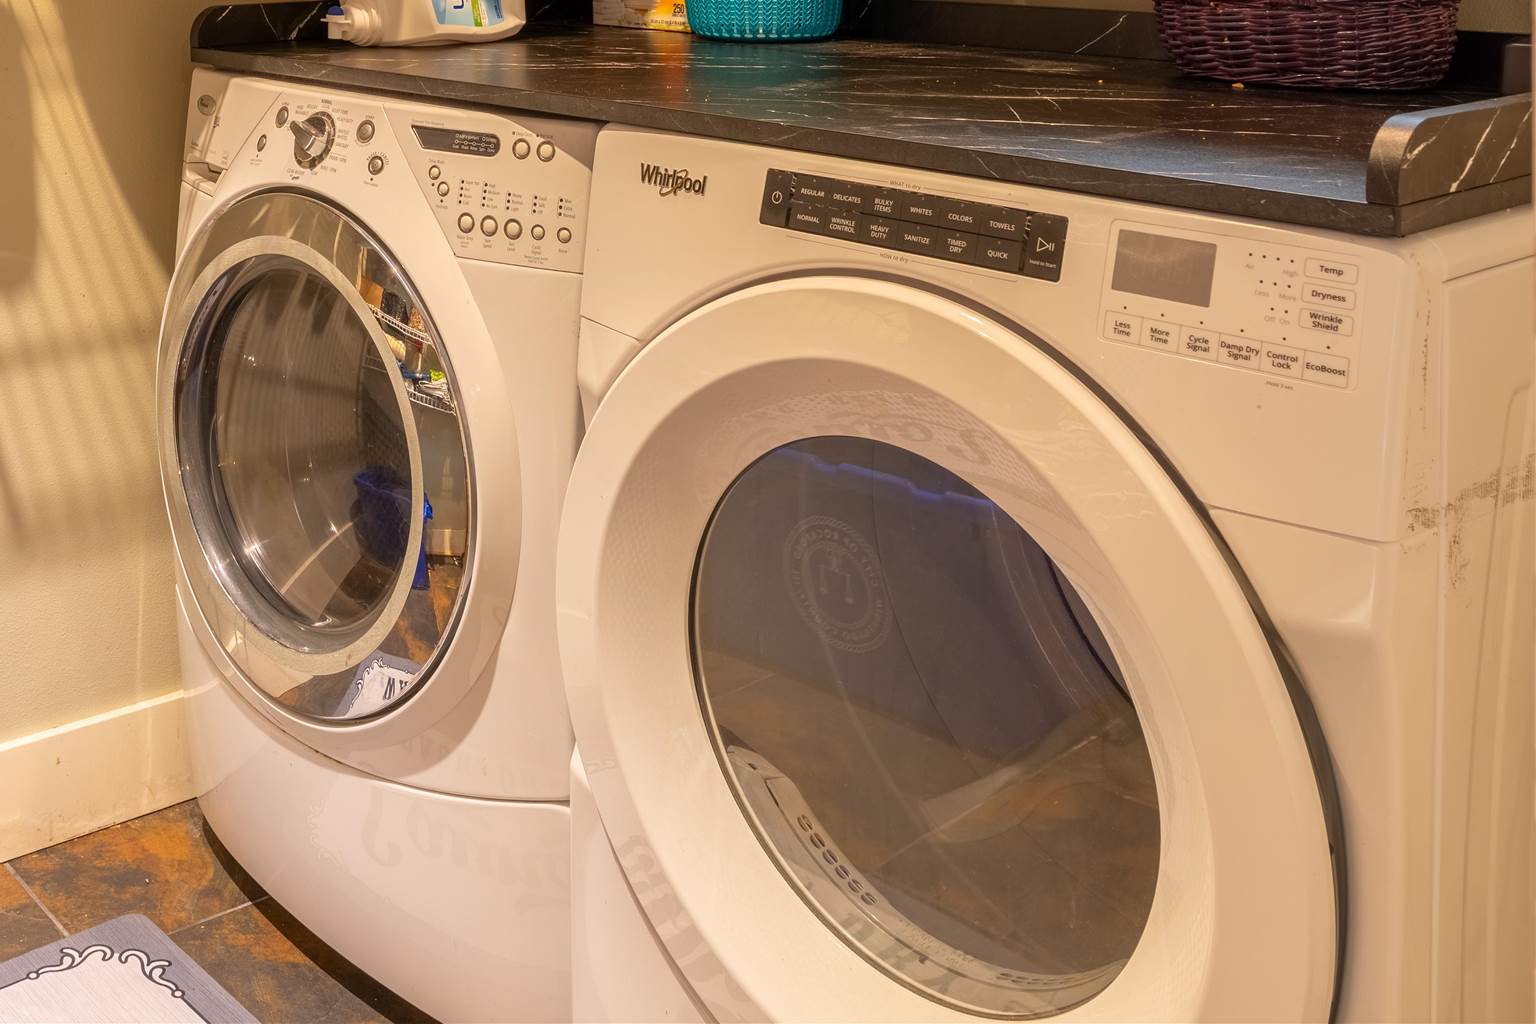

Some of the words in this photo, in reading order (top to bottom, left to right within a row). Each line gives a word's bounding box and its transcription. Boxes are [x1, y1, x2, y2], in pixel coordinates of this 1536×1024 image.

[673, 3, 685, 14] 250
[640, 161, 707, 197] Whirlpool
[800, 187, 825, 198] REGULAR
[833, 193, 862, 204] DELICATES
[874, 197, 894, 207] BULKY
[874, 204, 892, 214] ITEMS
[909, 206, 933, 216] WHITES
[796, 213, 820, 224] NORMAL
[831, 216, 856, 227] WRINKLE
[947, 212, 973, 224] COLORS
[829, 224, 856, 234] CONTROL
[870, 224, 890, 233] HEAVY
[989, 220, 1015, 231] TOWELS
[870, 231, 887, 240] DUTY
[904, 233, 930, 245] SANITIZE
[947, 237, 967, 248] TIMED
[949, 245, 963, 254] DRY
[987, 248, 1009, 260] QUICK
[1319, 264, 1344, 277] Temp
[1278, 292, 1297, 303] More
[1311, 289, 1346, 304] Dryness
[1309, 311, 1343, 325] Wrinkle
[1114, 319, 1131, 330] Less
[1311, 319, 1339, 333] Shield
[1112, 327, 1132, 338] Time
[1150, 327, 1170, 338] More
[1149, 334, 1169, 346] Time
[1188, 334, 1210, 347] Cycle
[1186, 342, 1210, 354] Signal
[1220, 340, 1245, 355] Damp
[1245, 346, 1260, 358] Dry
[1226, 350, 1251, 362] Signal
[1266, 350, 1298, 364] Control
[1271, 359, 1292, 371] Lock
[1305, 362, 1346, 377] EcoBoost
